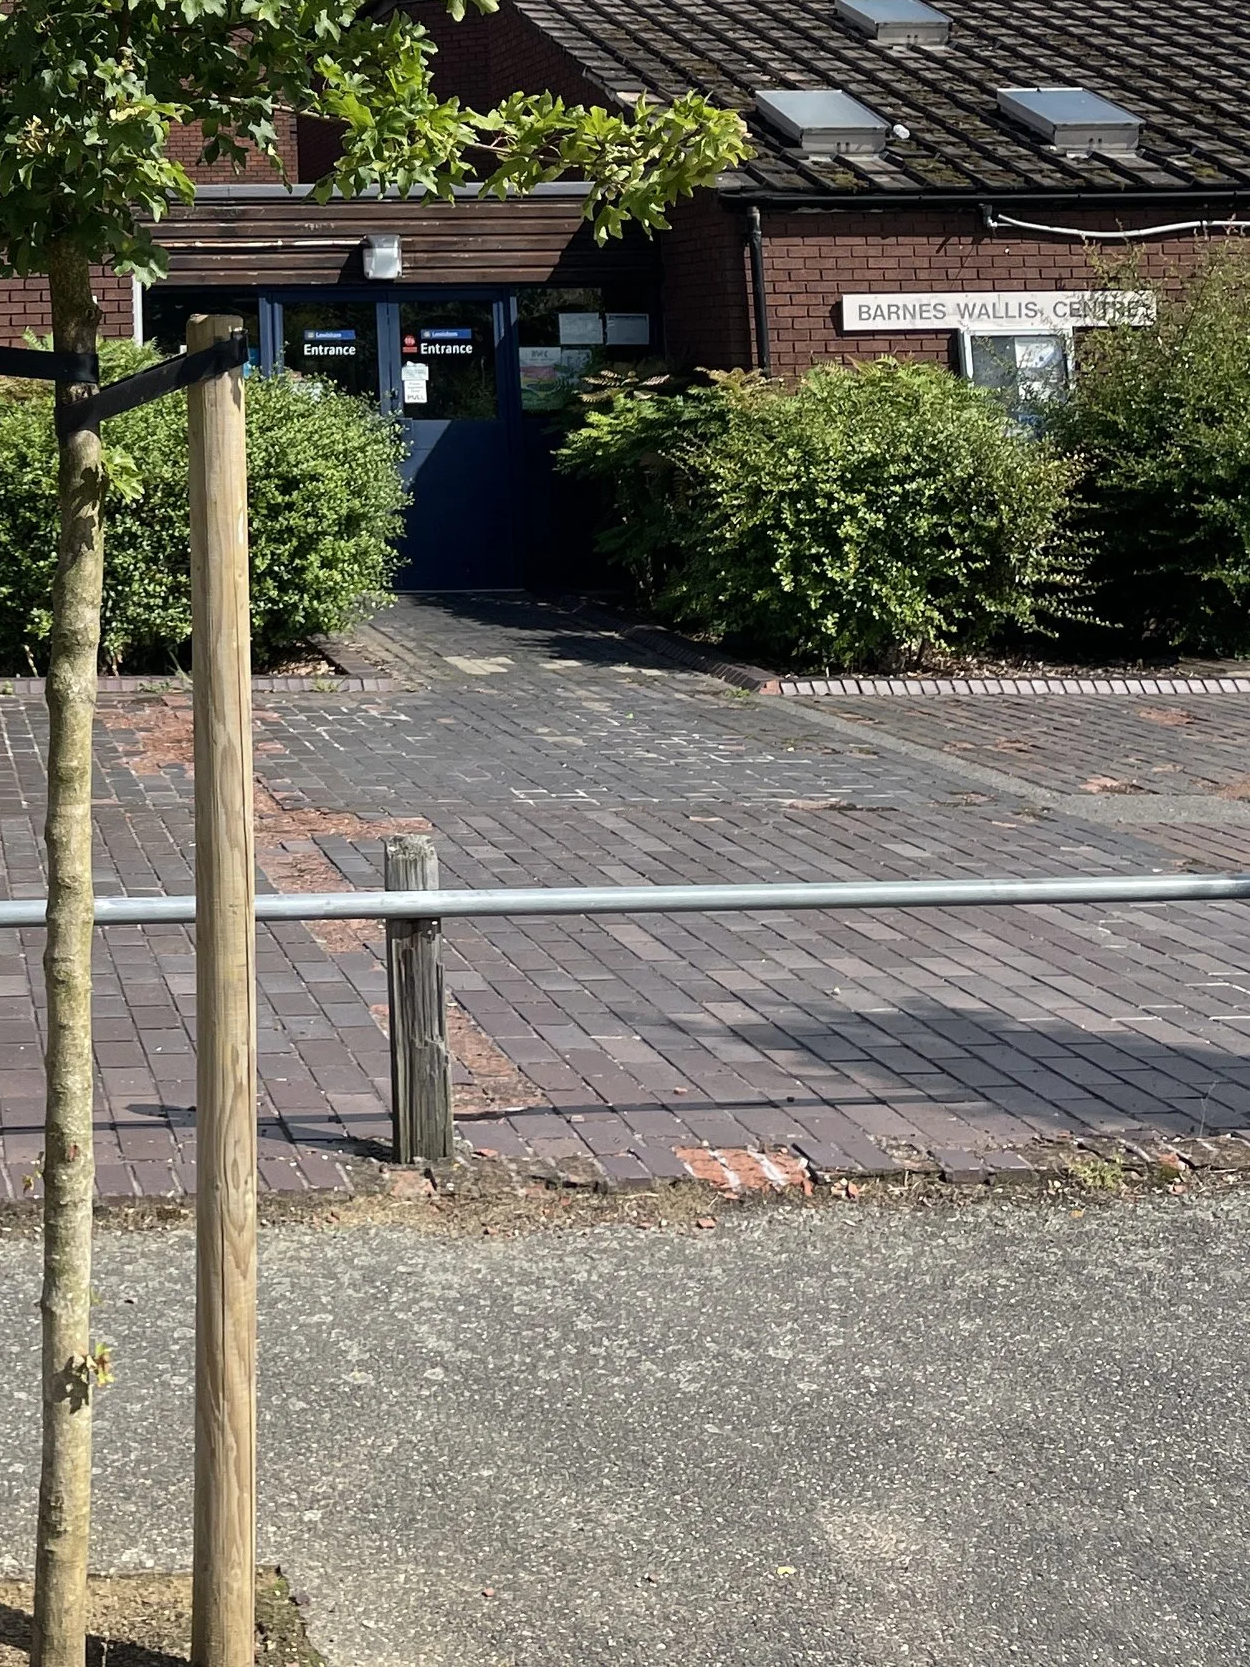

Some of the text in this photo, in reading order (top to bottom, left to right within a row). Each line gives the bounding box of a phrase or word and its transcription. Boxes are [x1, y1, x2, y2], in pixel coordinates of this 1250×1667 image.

[857, 302, 947, 321] BARNES
[956, 301, 1038, 320] WALLIS
[303, 343, 356, 356] Entrance
[420, 342, 473, 355] Entrance
